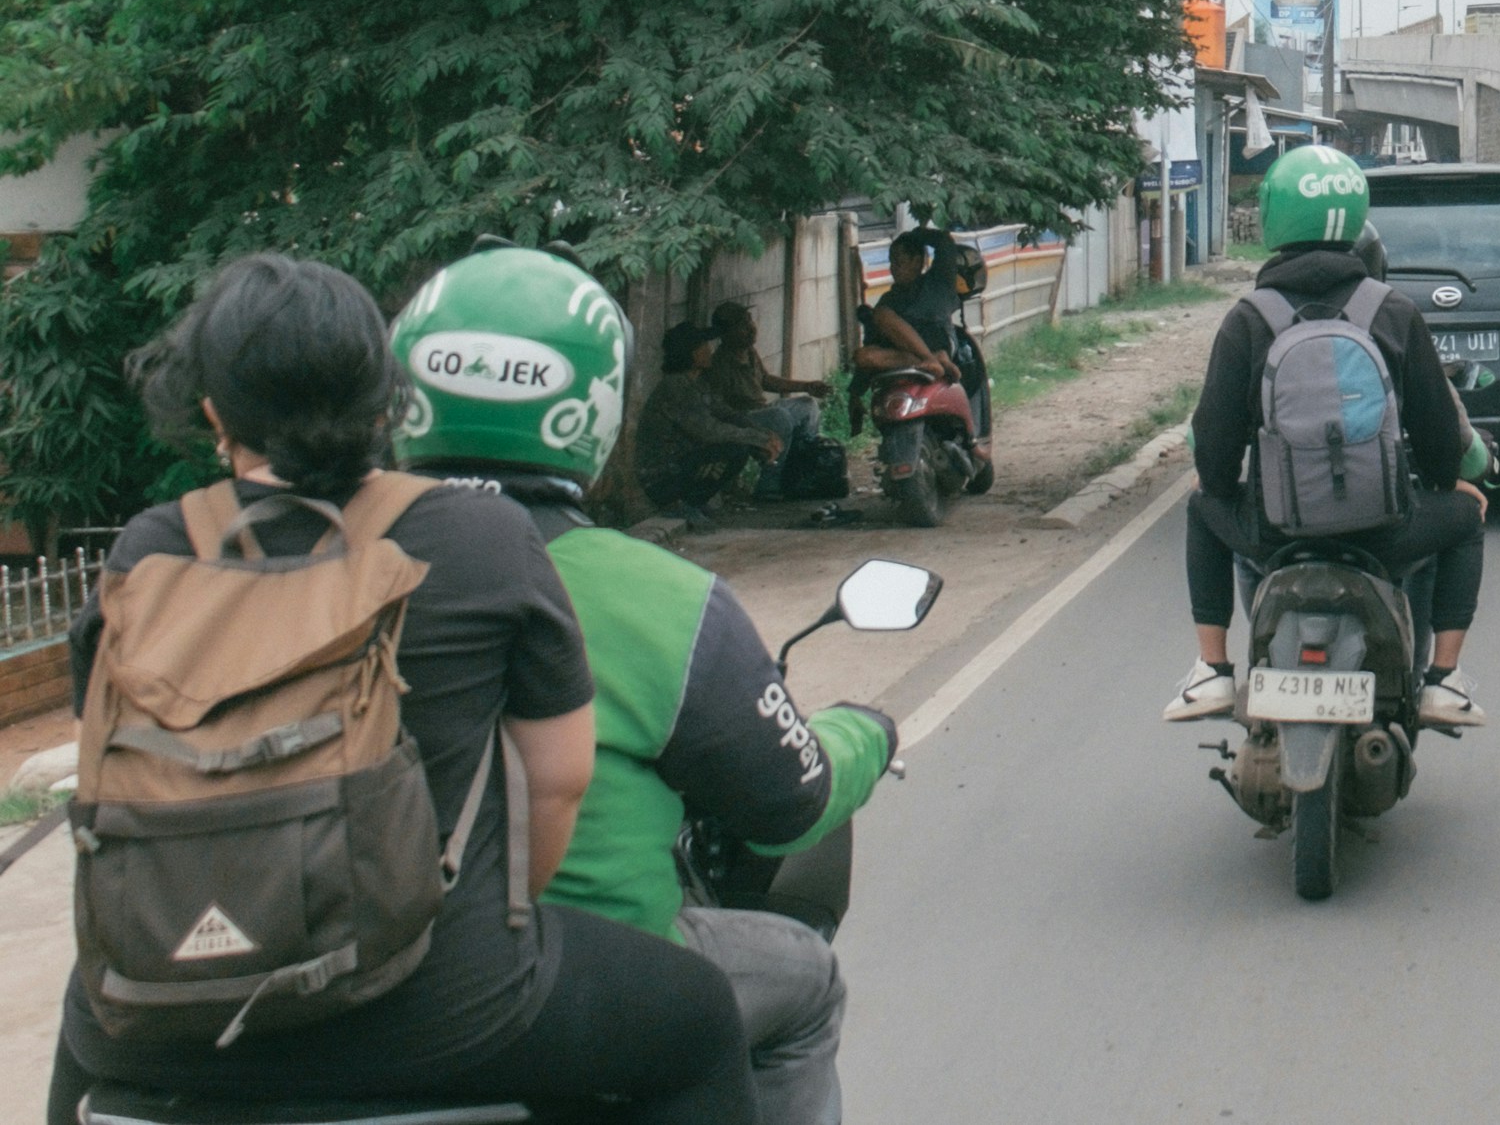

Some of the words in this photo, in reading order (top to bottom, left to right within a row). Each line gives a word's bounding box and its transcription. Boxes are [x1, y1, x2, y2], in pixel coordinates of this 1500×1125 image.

[1298, 167, 1365, 198] Grab
[427, 350, 463, 376] GO
[498, 359, 551, 387] JEK
[1253, 674, 1265, 693] B
[1278, 676, 1324, 695] 4318
[1334, 677, 1370, 696] NLK
[757, 682, 824, 784] gopay
